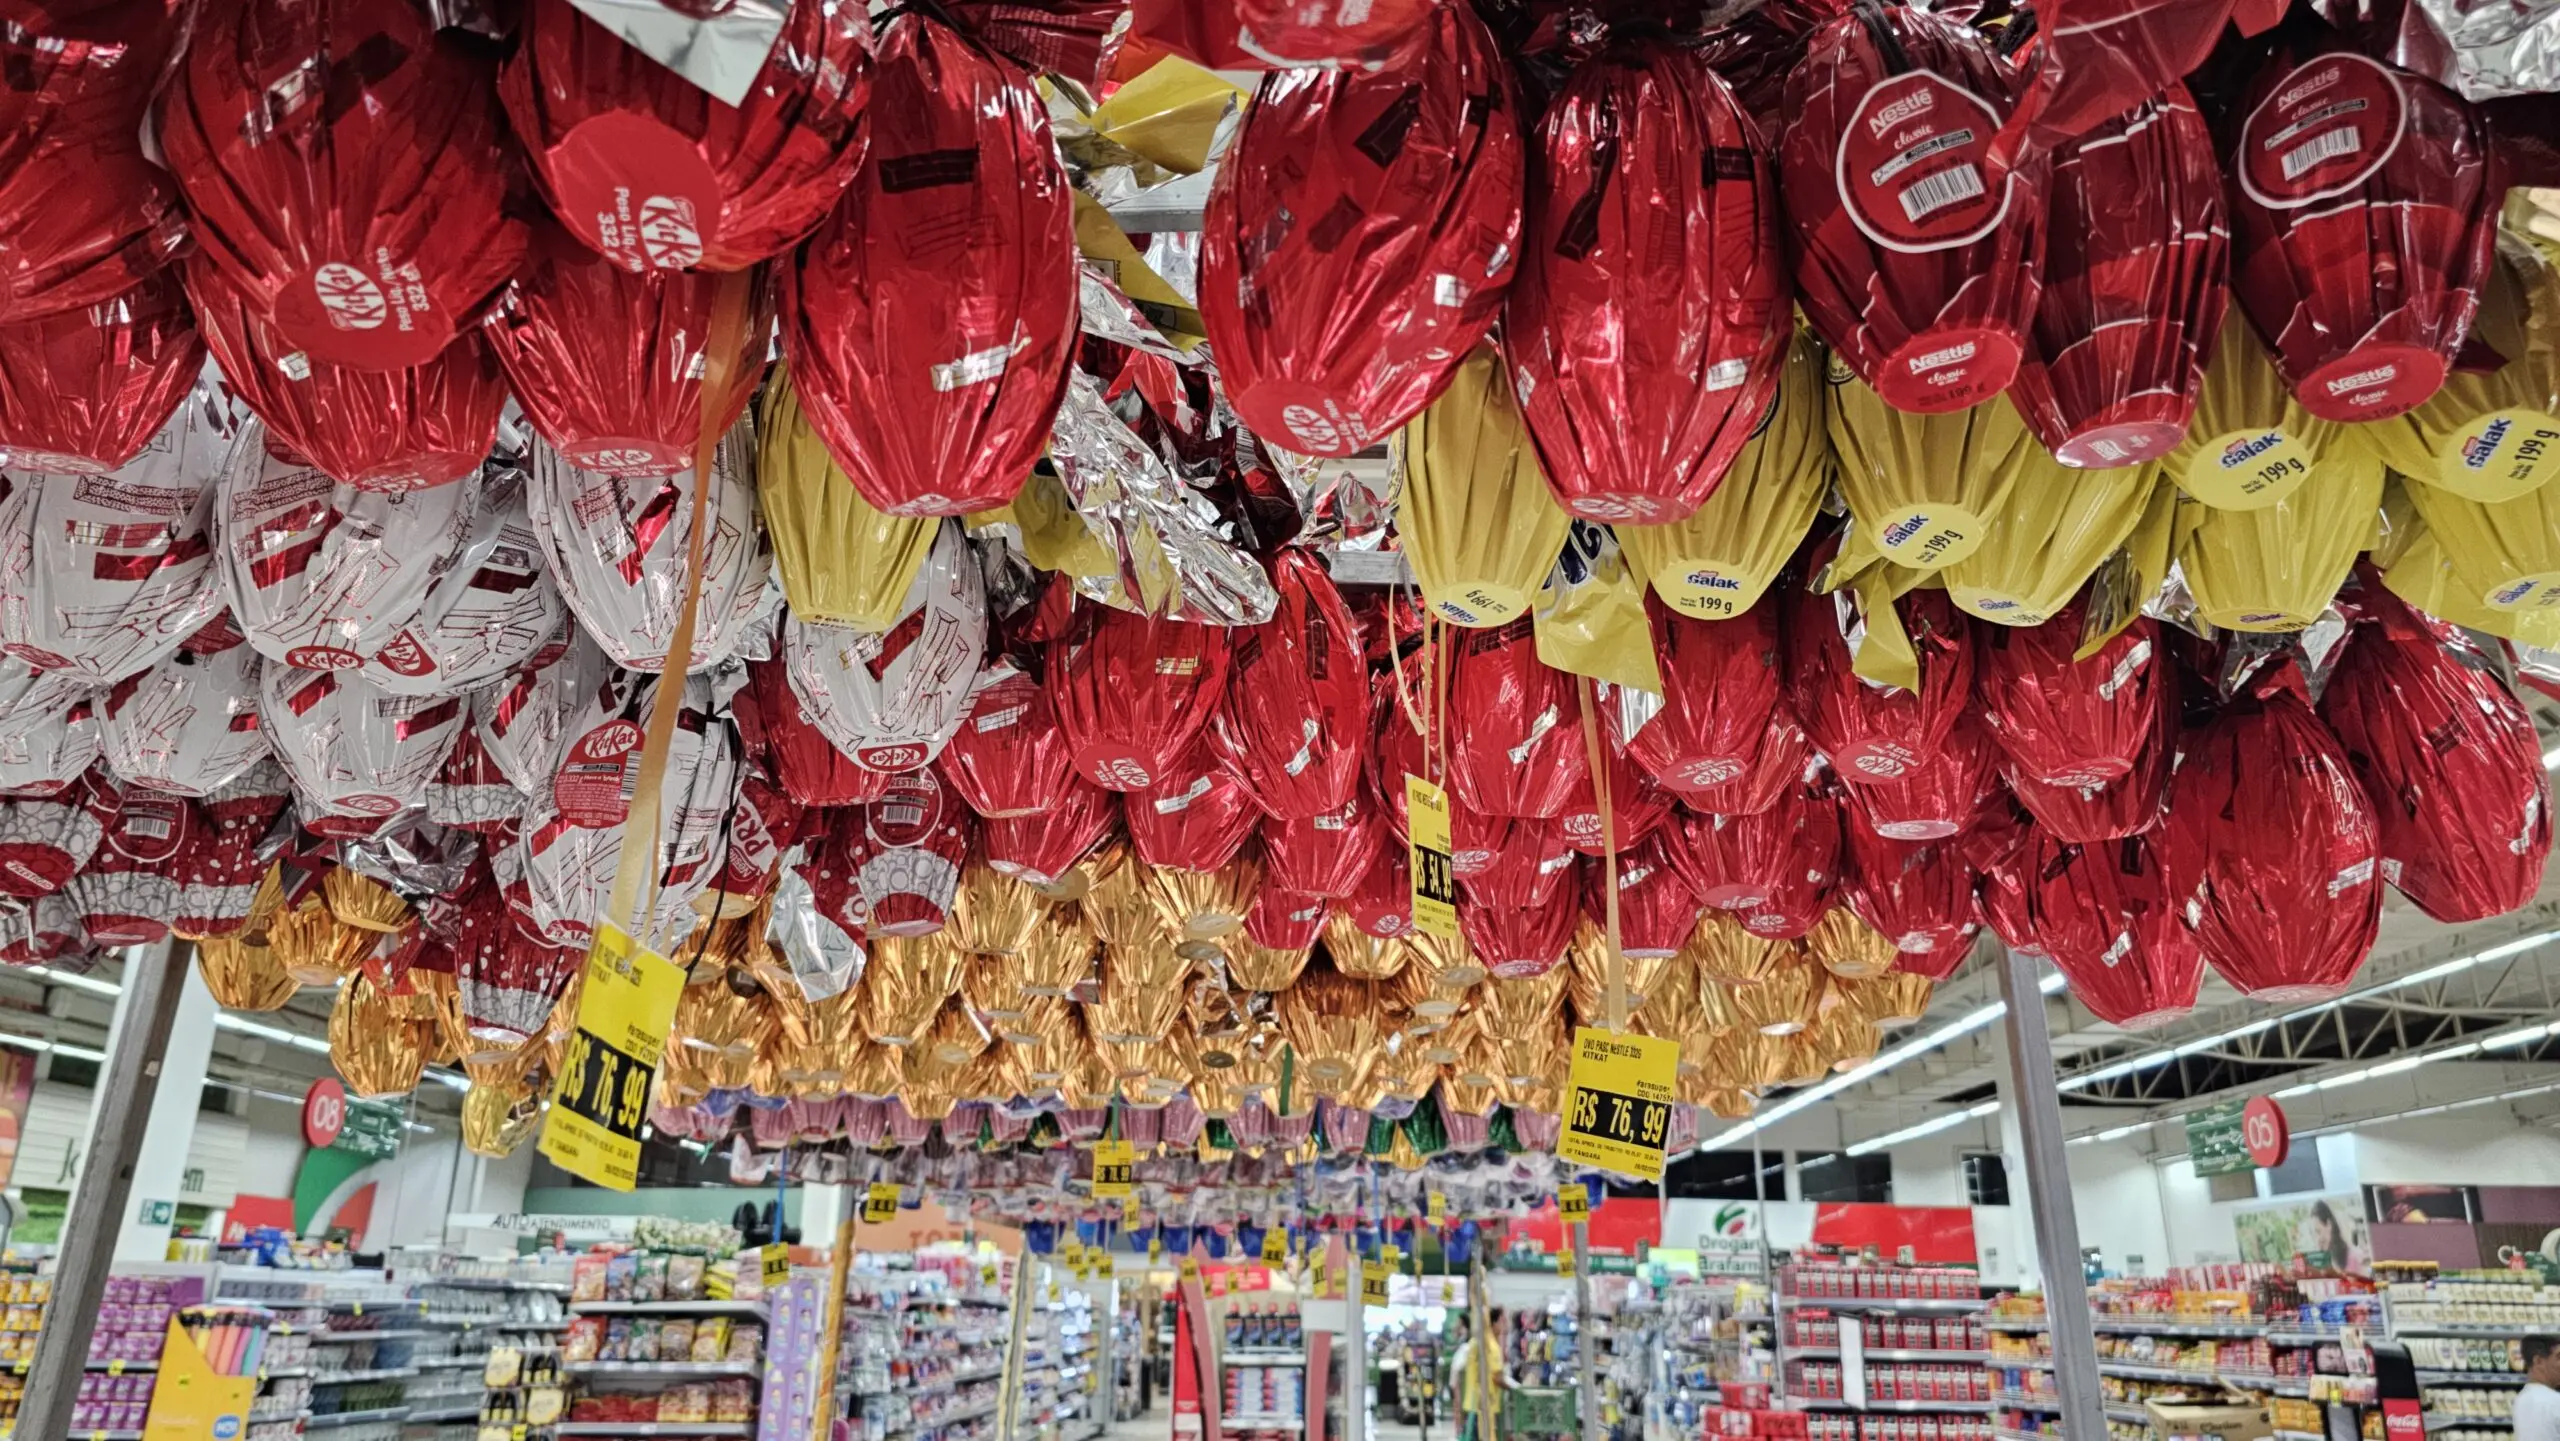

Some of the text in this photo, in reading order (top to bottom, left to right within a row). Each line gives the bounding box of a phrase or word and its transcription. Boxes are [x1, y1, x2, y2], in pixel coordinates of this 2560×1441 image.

[613, 186, 632, 223] Peso
[597, 211, 620, 248] 332
[316, 267, 387, 323] KitKat
[406, 283, 431, 312] 332
[2221, 432, 2284, 469] Galak
[2466, 418, 2512, 468] Galak
[2514, 430, 2560, 461] 199 g
[2257, 460, 2289, 484] 199
[2290, 457, 2306, 473] g
[1886, 514, 1929, 547] Galak
[1923, 529, 1964, 552] 199 g
[1687, 573, 1740, 590] Galak
[1470, 595, 1494, 608] 199
[1698, 596, 1722, 610] 199
[1724, 600, 1733, 614] g
[300, 651, 356, 670] KitKat
[588, 725, 636, 757] KitKat
[871, 748, 919, 766] KitKat
[1582, 1051, 1609, 1063] KITKAT
[1610, 1043, 1630, 1057] NESTLE
[564, 1032, 648, 1130] R$ 76,99
[312, 1094, 341, 1132] 08
[1572, 1090, 1667, 1144] R$ 76,99
[2248, 1112, 2275, 1150] 05
